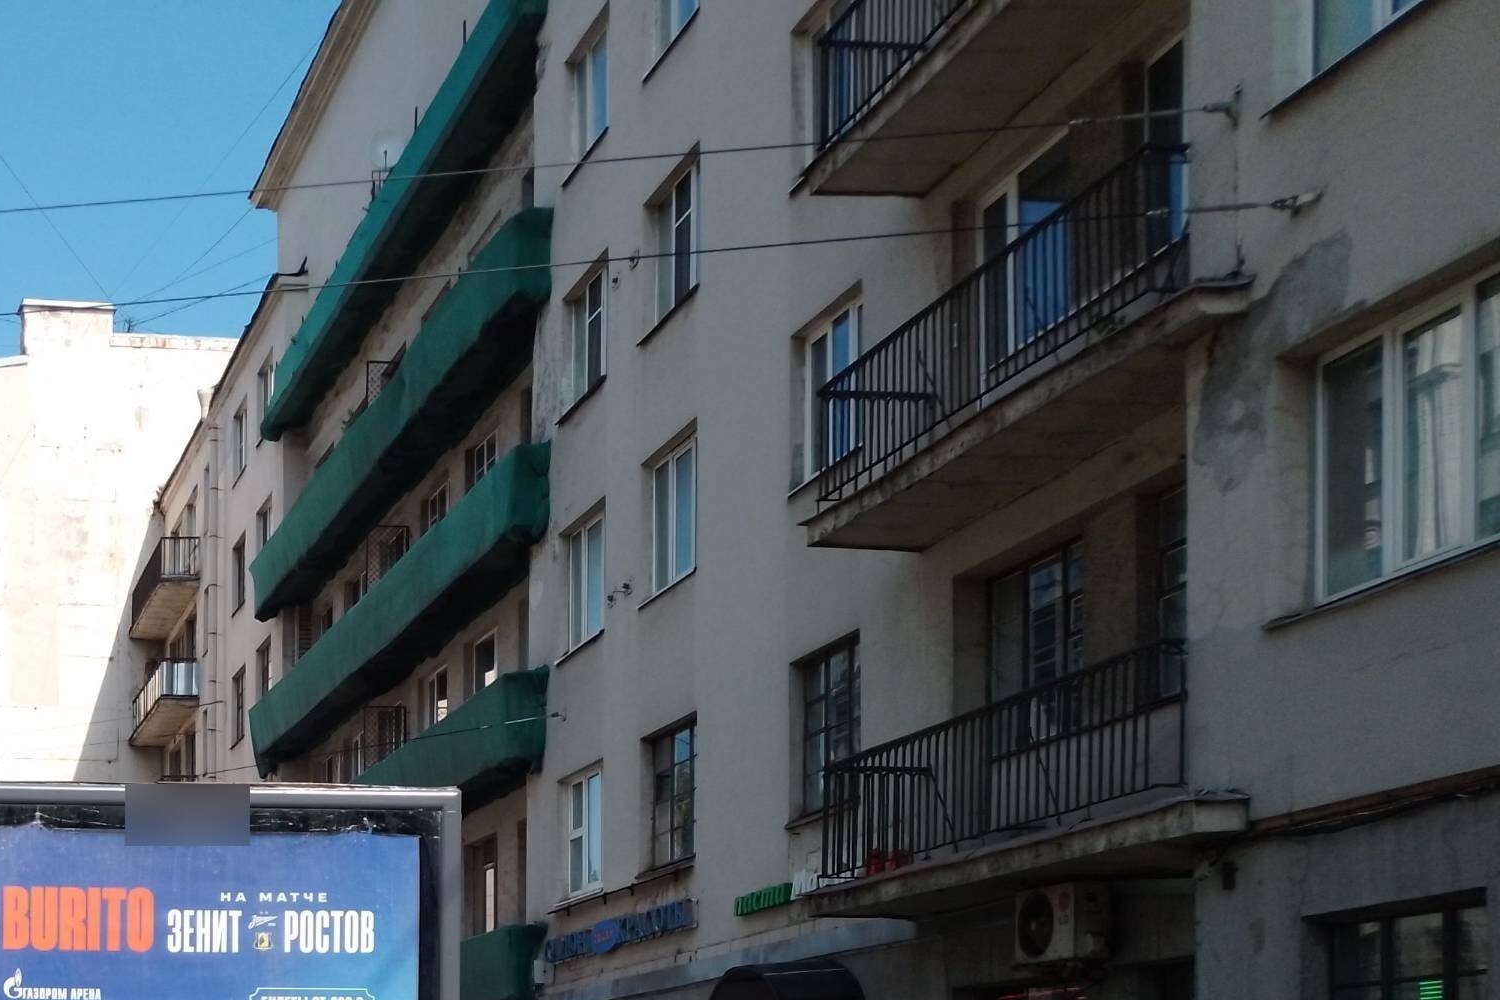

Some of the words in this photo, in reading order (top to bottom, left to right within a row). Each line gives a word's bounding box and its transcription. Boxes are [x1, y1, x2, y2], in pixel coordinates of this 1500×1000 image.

[220, 892, 247, 902] НА
[259, 892, 328, 903] МАТЧЕ
[3, 886, 155, 952] BURITO
[167, 909, 242, 953] ЗЕНИТ
[284, 910, 374, 954] РОСТОВ
[71, 988, 101, 1000] АРЕНА
